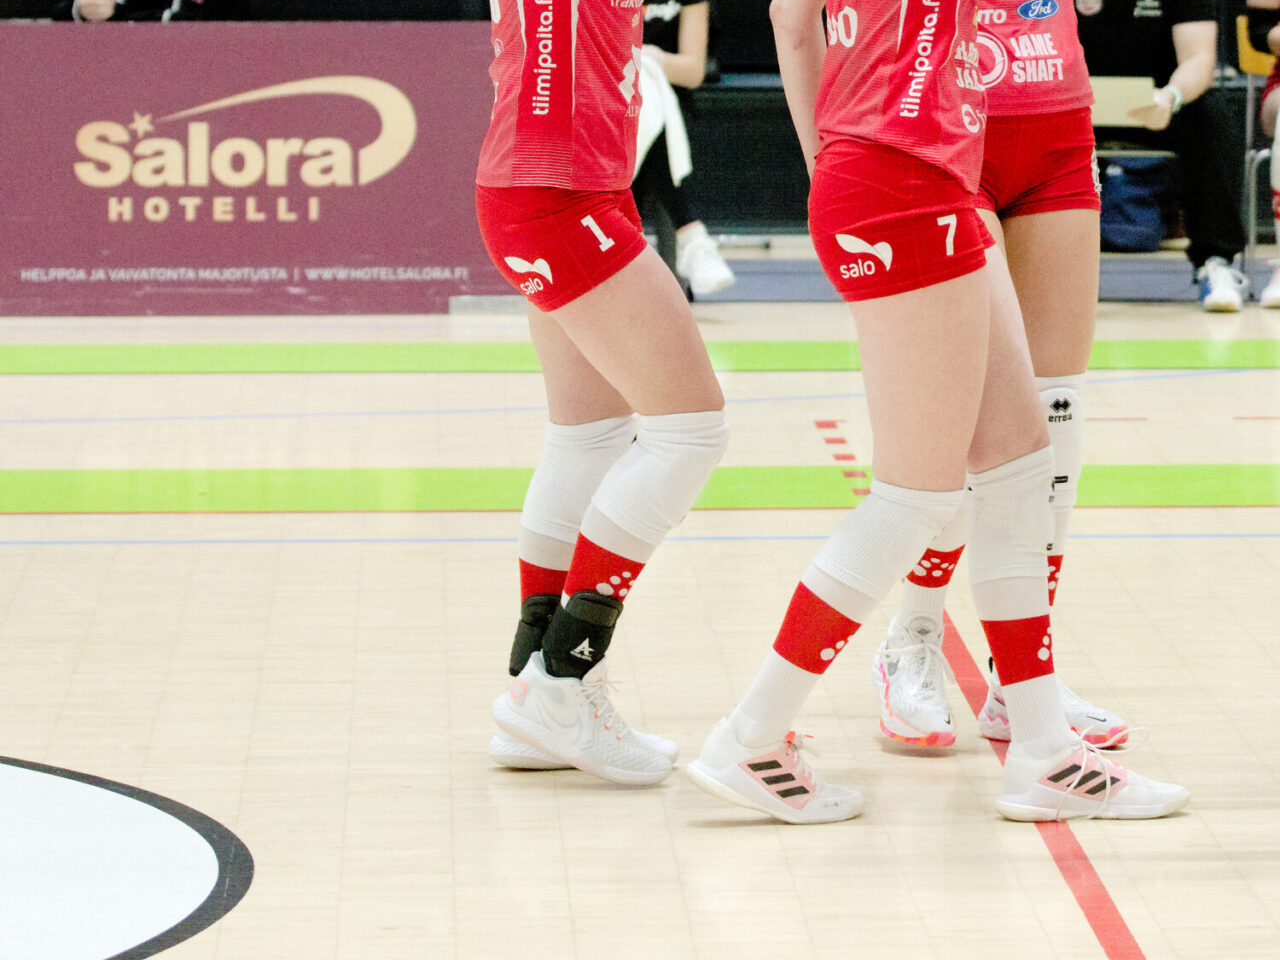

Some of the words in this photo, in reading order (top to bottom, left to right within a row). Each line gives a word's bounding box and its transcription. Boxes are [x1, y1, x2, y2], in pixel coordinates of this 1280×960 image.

[1011, 58, 1064, 83] SHAFT
[73, 120, 354, 189] Salora
[106, 196, 322, 223] HOTELLI
[580, 214, 616, 253] 1
[936, 213, 958, 257] 7
[840, 258, 876, 279] salo
[520, 277, 545, 296] salo
